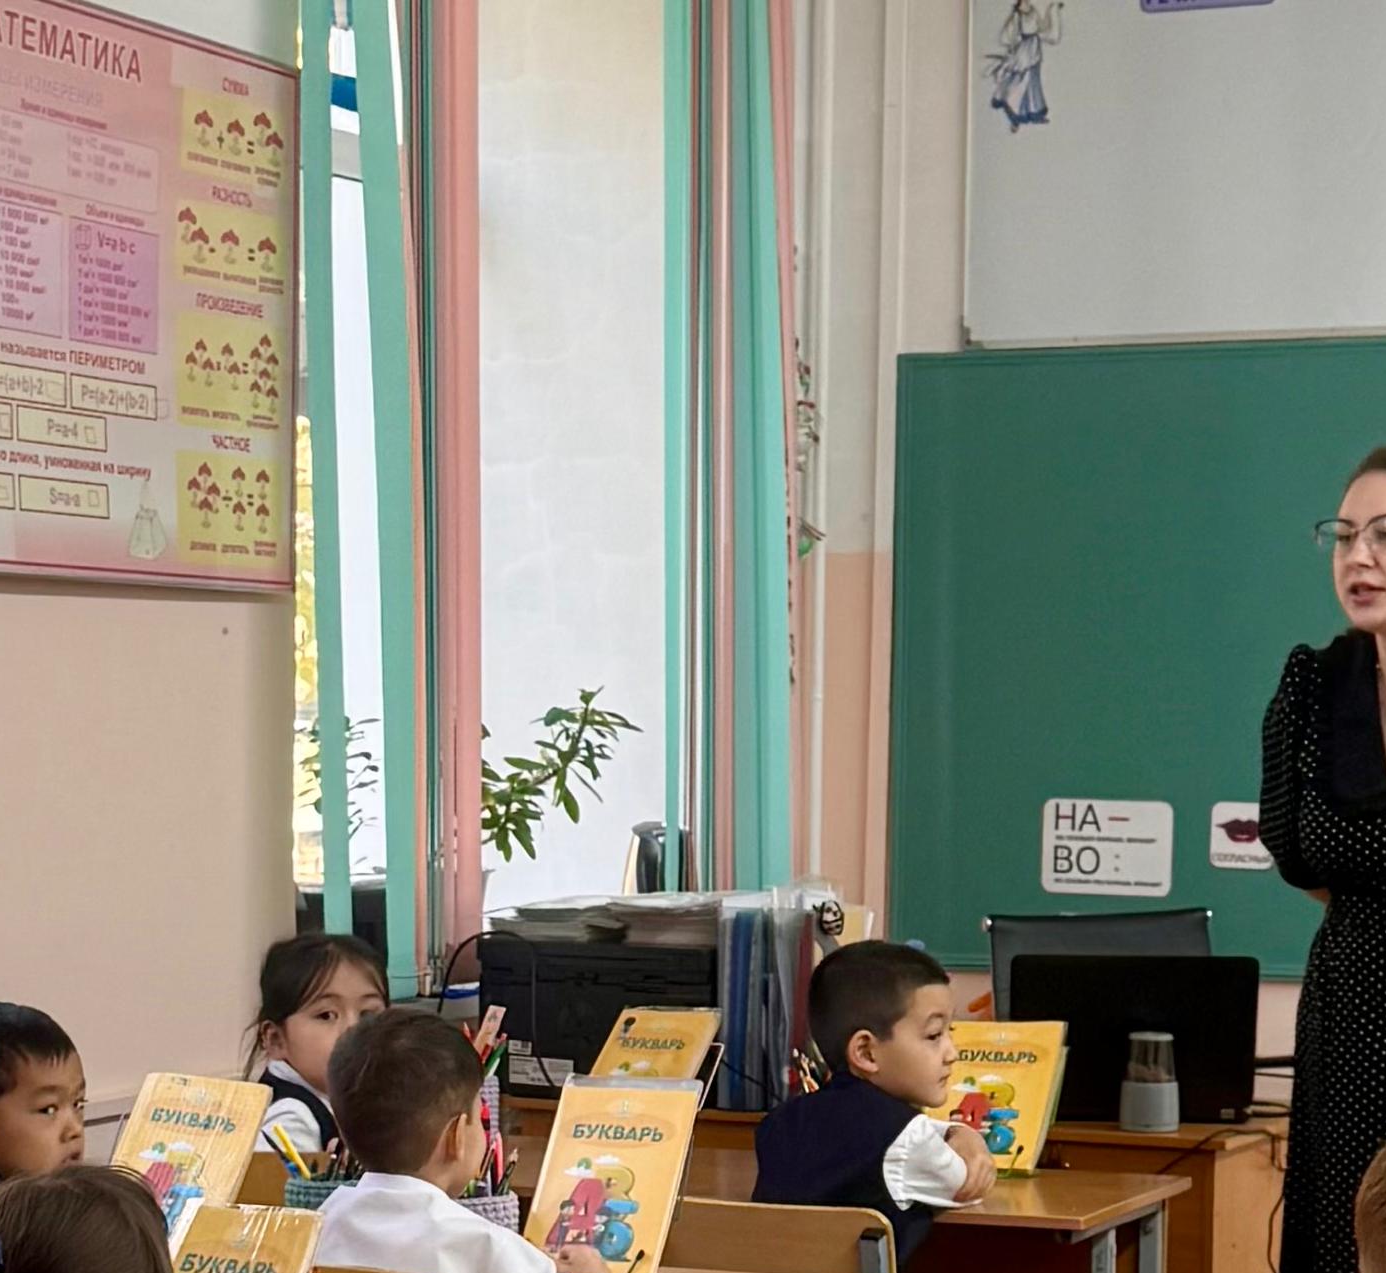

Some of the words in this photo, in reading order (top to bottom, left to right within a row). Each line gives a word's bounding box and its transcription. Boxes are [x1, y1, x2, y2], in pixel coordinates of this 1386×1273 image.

[0, 342, 67, 362] называется
[68, 350, 145, 375] ПЕРИМЕТРОМ
[1054, 802, 1101, 832] НА
[1053, 845, 1100, 875] ВО
[621, 1038, 685, 1051] БУКВАРЬ
[958, 1048, 1038, 1064] БУКВАРЬ
[150, 1106, 237, 1136] БУКВАРЬ
[572, 1123, 664, 1142] БУКВАРЬ
